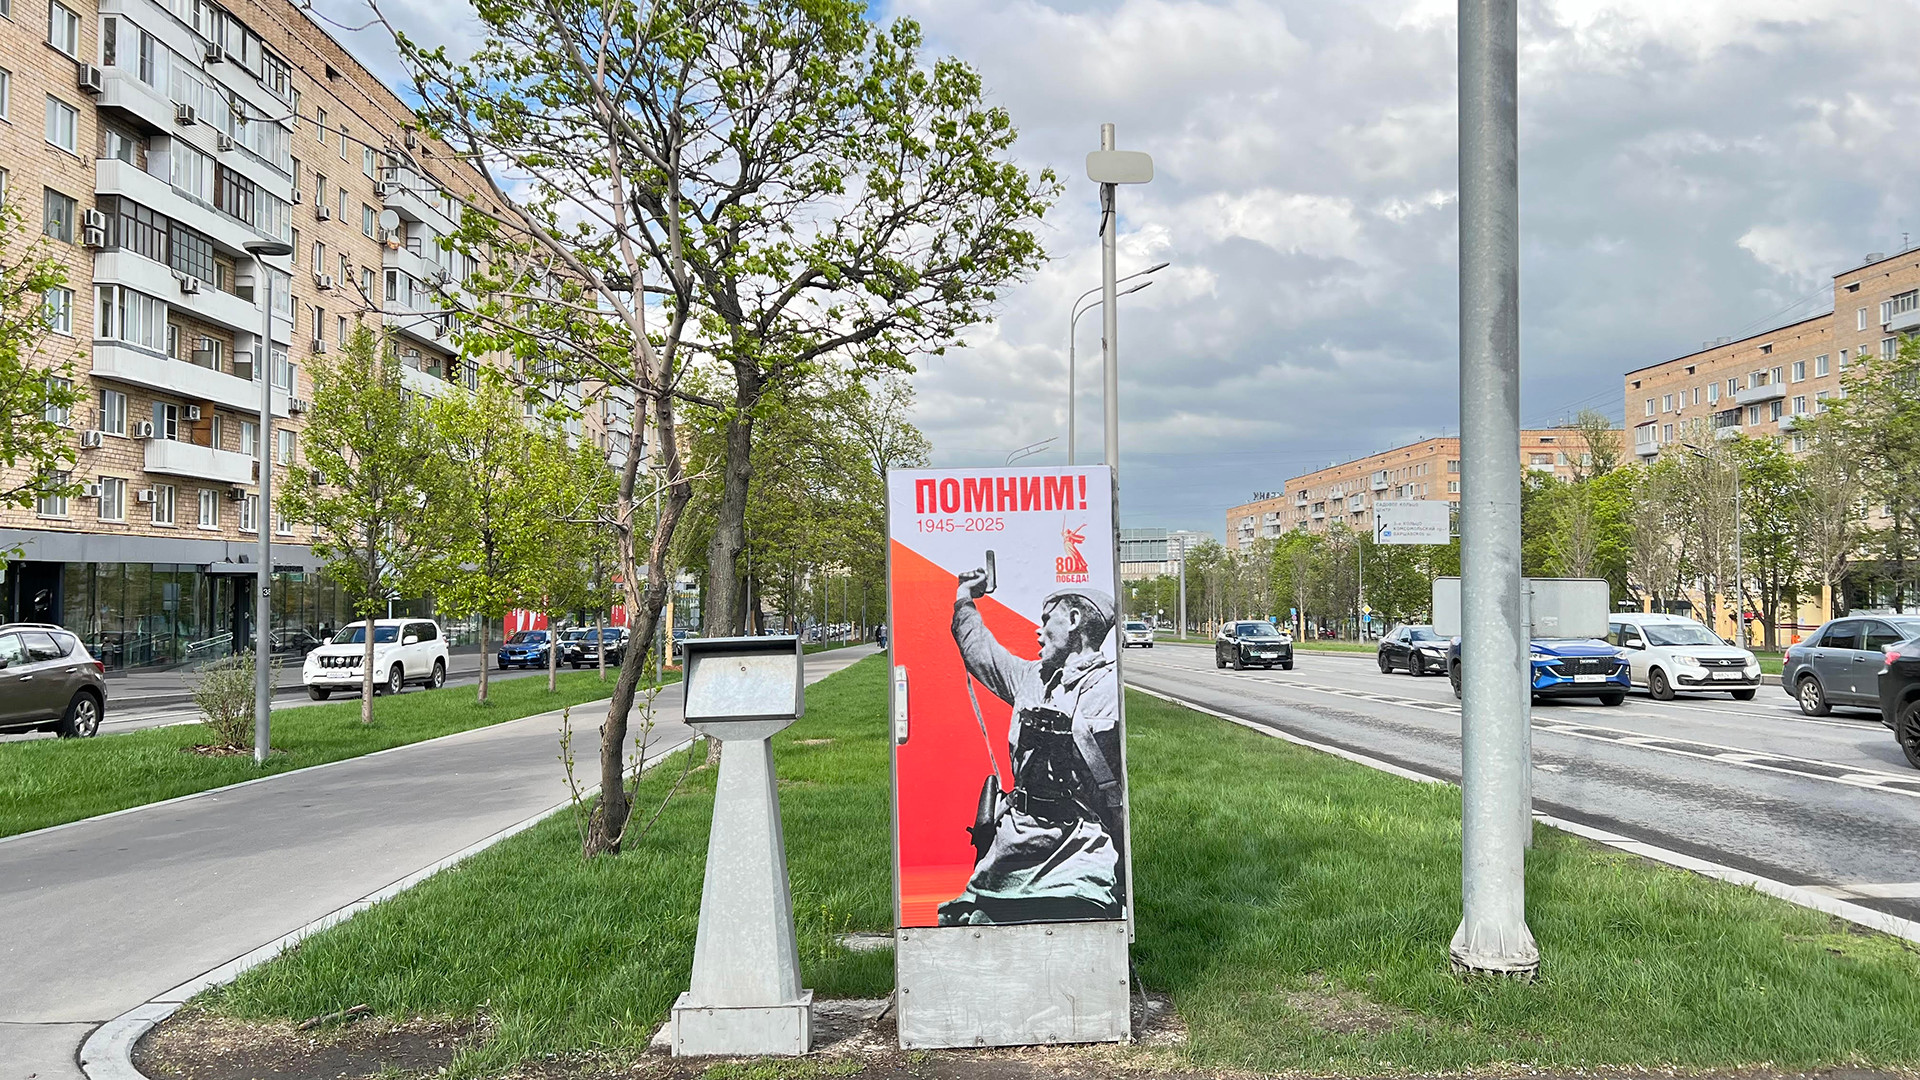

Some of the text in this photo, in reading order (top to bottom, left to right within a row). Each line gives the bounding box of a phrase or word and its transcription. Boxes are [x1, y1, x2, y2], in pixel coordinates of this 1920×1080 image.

[915, 475, 1087, 514] ПОМНИМ!
[1056, 556, 1074, 572] 80
[1056, 574, 1090, 584] ПОБЕДА!
